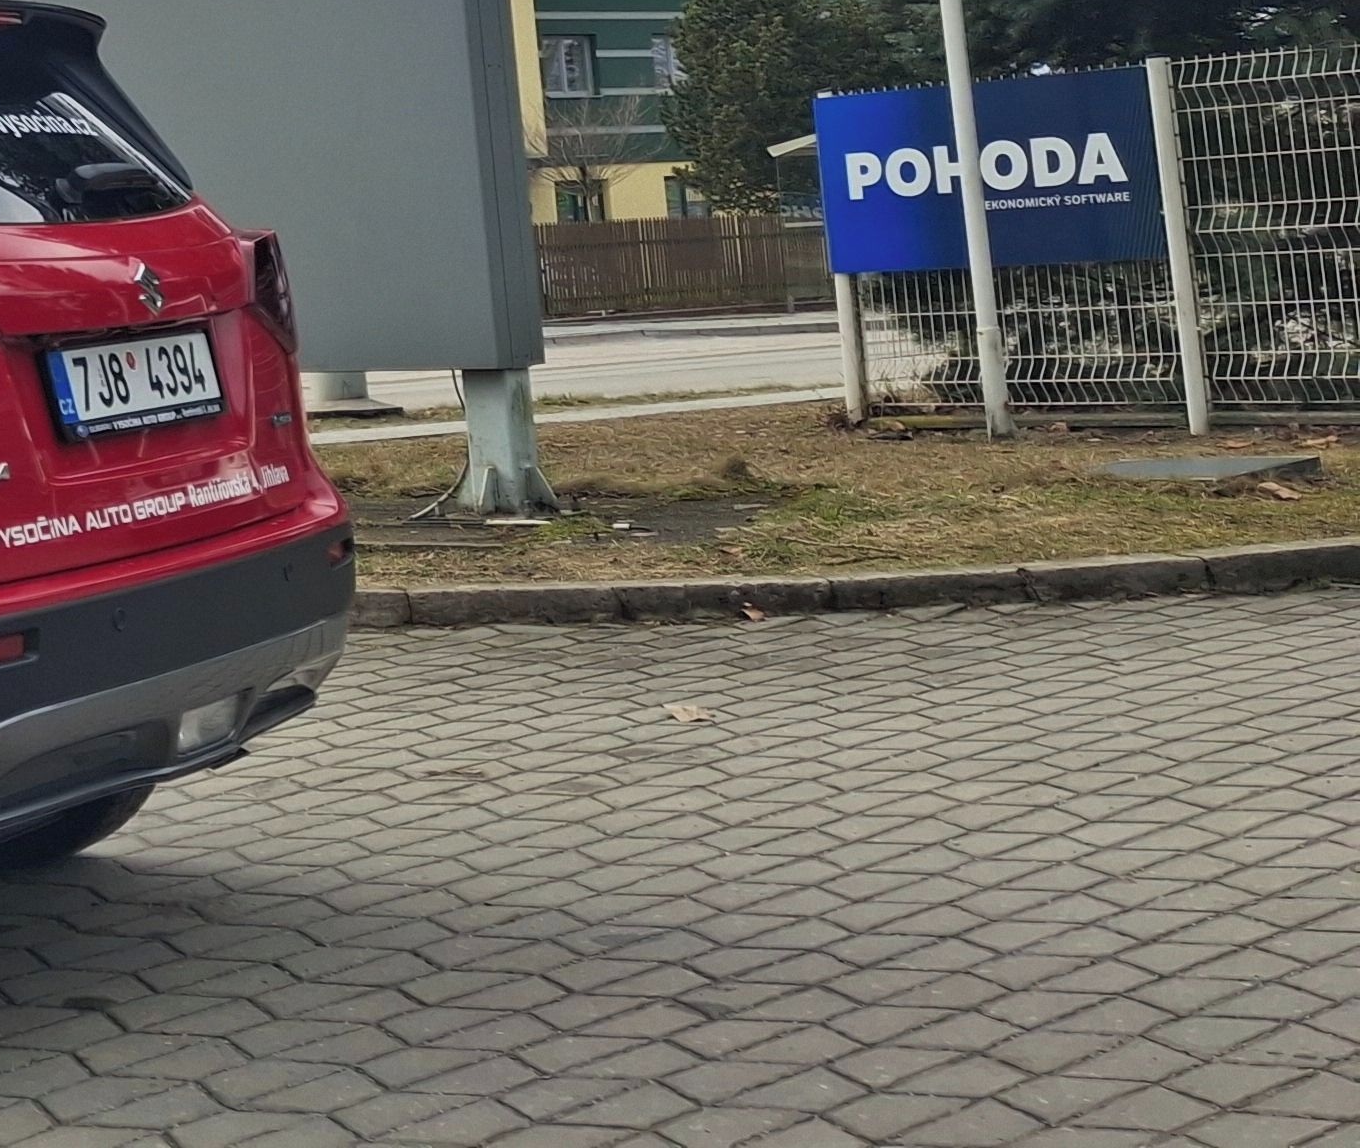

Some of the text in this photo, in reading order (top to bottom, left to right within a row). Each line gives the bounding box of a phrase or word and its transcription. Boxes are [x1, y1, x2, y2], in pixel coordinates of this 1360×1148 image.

[844, 132, 1129, 201] POHODA
[984, 191, 1130, 211] EKONOMICKÝ SOFTWARE
[72, 341, 206, 412] 7J8 4394
[59, 398, 75, 416] CZ
[86, 504, 133, 532] AUTO
[134, 491, 186, 521] GROUP
